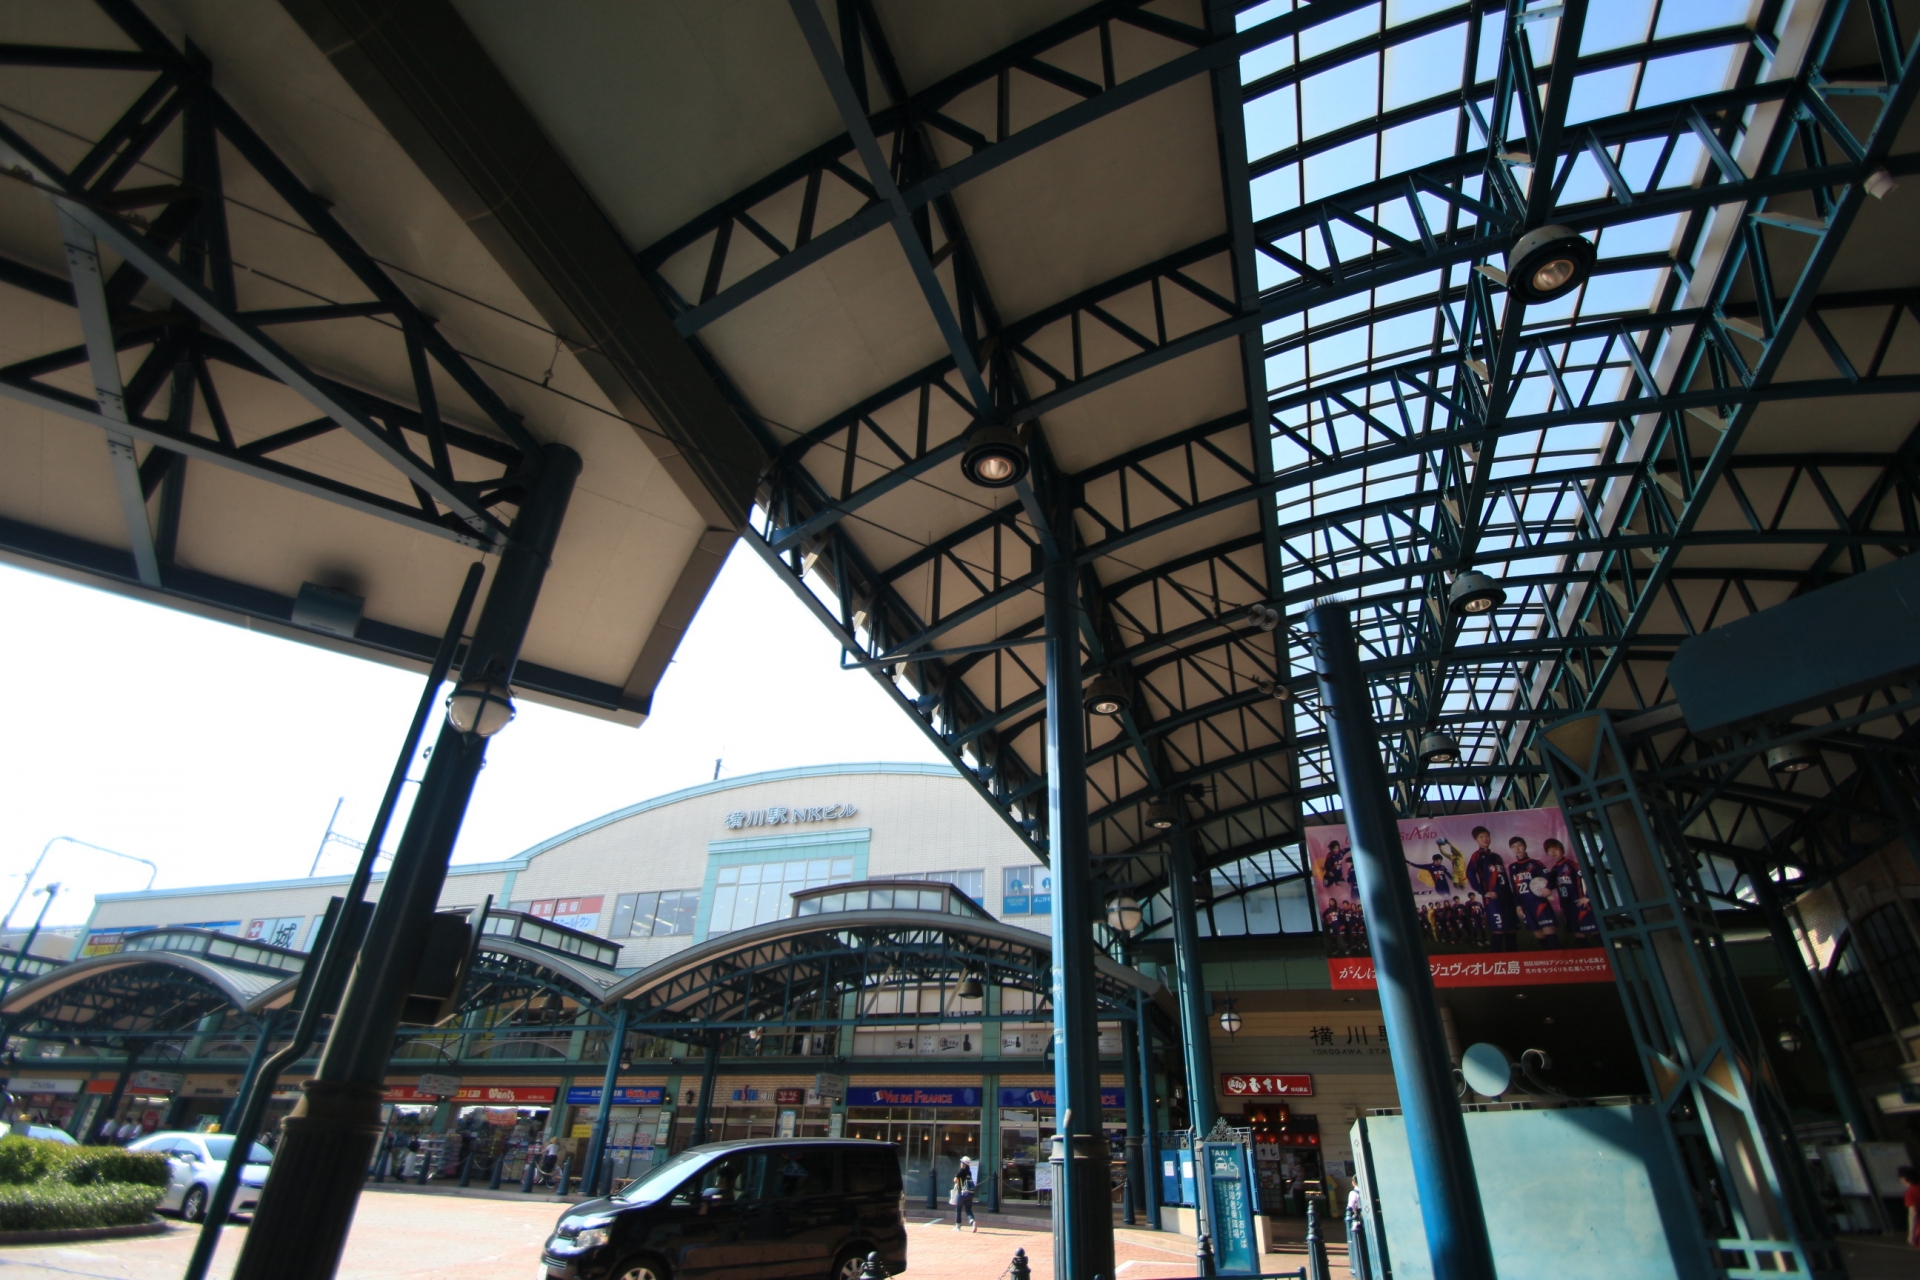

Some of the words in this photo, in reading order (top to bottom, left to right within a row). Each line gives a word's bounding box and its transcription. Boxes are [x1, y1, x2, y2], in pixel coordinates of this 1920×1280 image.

[1430, 961, 1520, 977] ジュヴィオレ広島
[488, 1088, 515, 1101] Wants
[883, 1089, 898, 1103] VIE
[900, 1094, 913, 1104] DE
[914, 1090, 952, 1104] FRANCE
[1234, 1182, 1248, 1249] タクシーおりば
